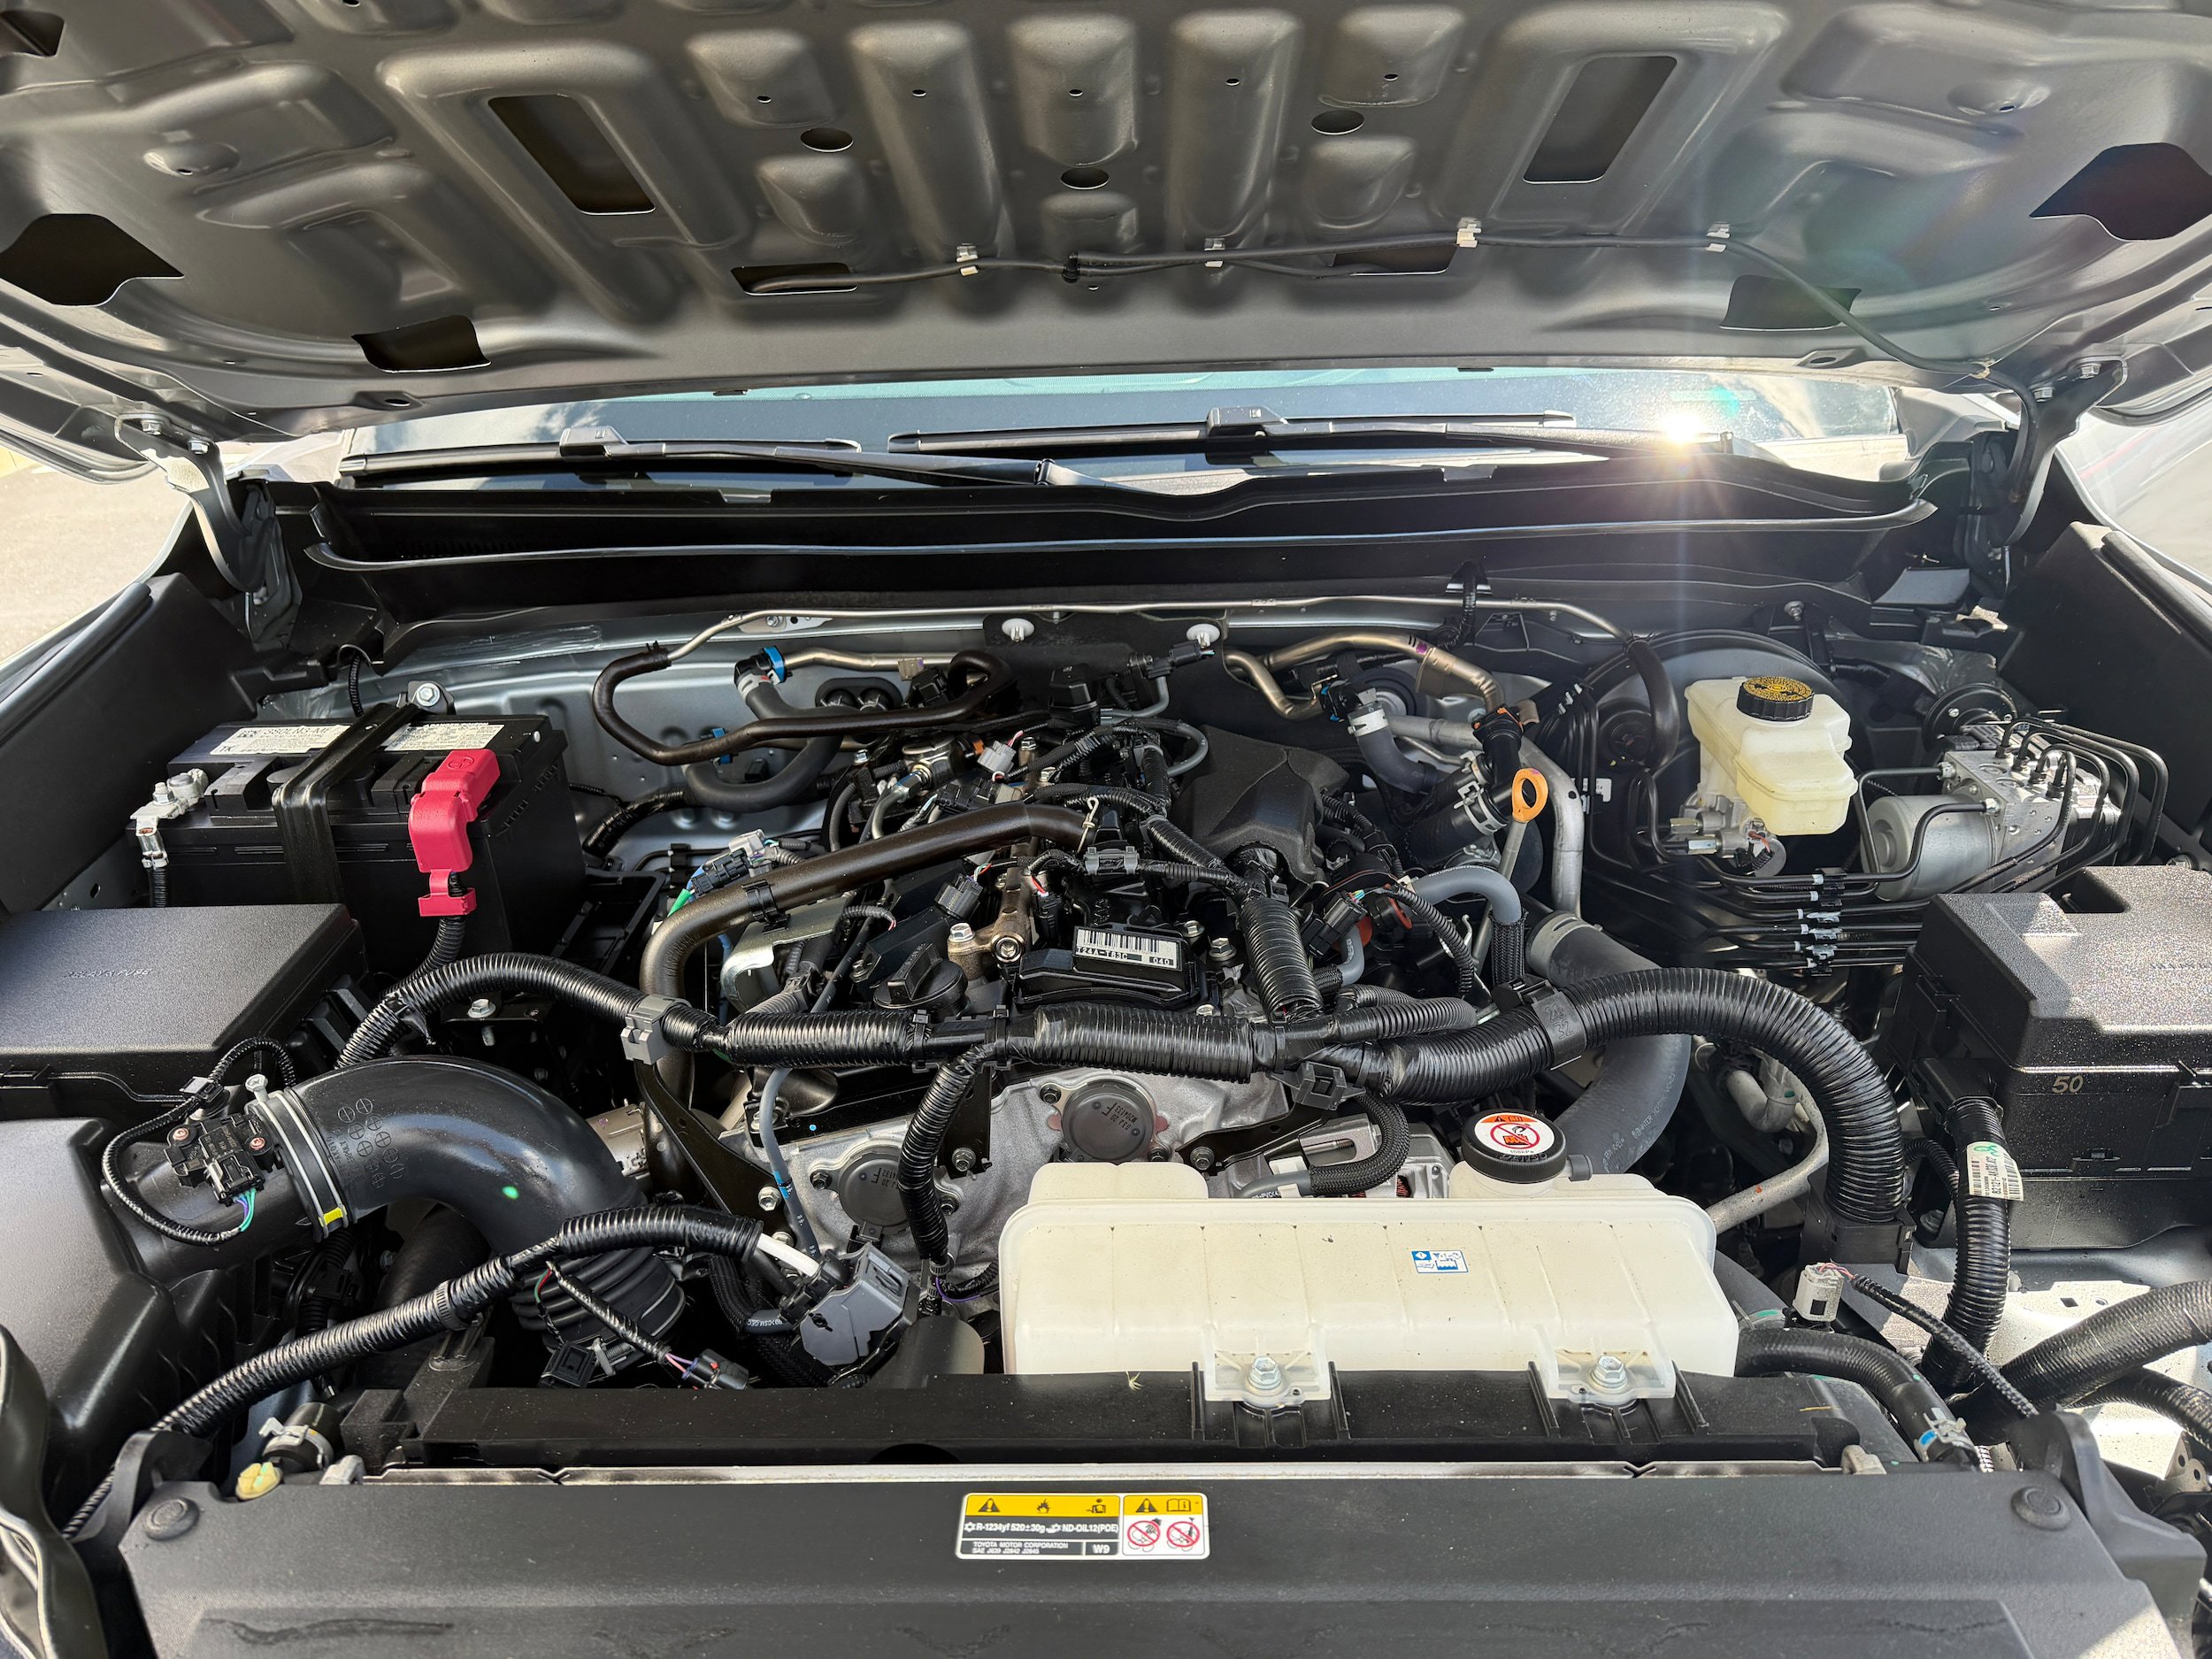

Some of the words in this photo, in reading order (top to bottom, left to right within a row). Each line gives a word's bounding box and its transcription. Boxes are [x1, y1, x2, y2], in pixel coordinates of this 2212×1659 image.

[1152, 956, 1171, 965] 040
[1553, 1018, 1575, 1040] 32
[2052, 1075, 2084, 1094] 50
[1101, 1102, 1118, 1117] F
[871, 1167, 882, 1184] F
[976, 1522, 1010, 1533] R-1234yf
[1062, 1523, 1119, 1534] ND-OIL12(POE)
[1093, 1544, 1110, 1555] W9
